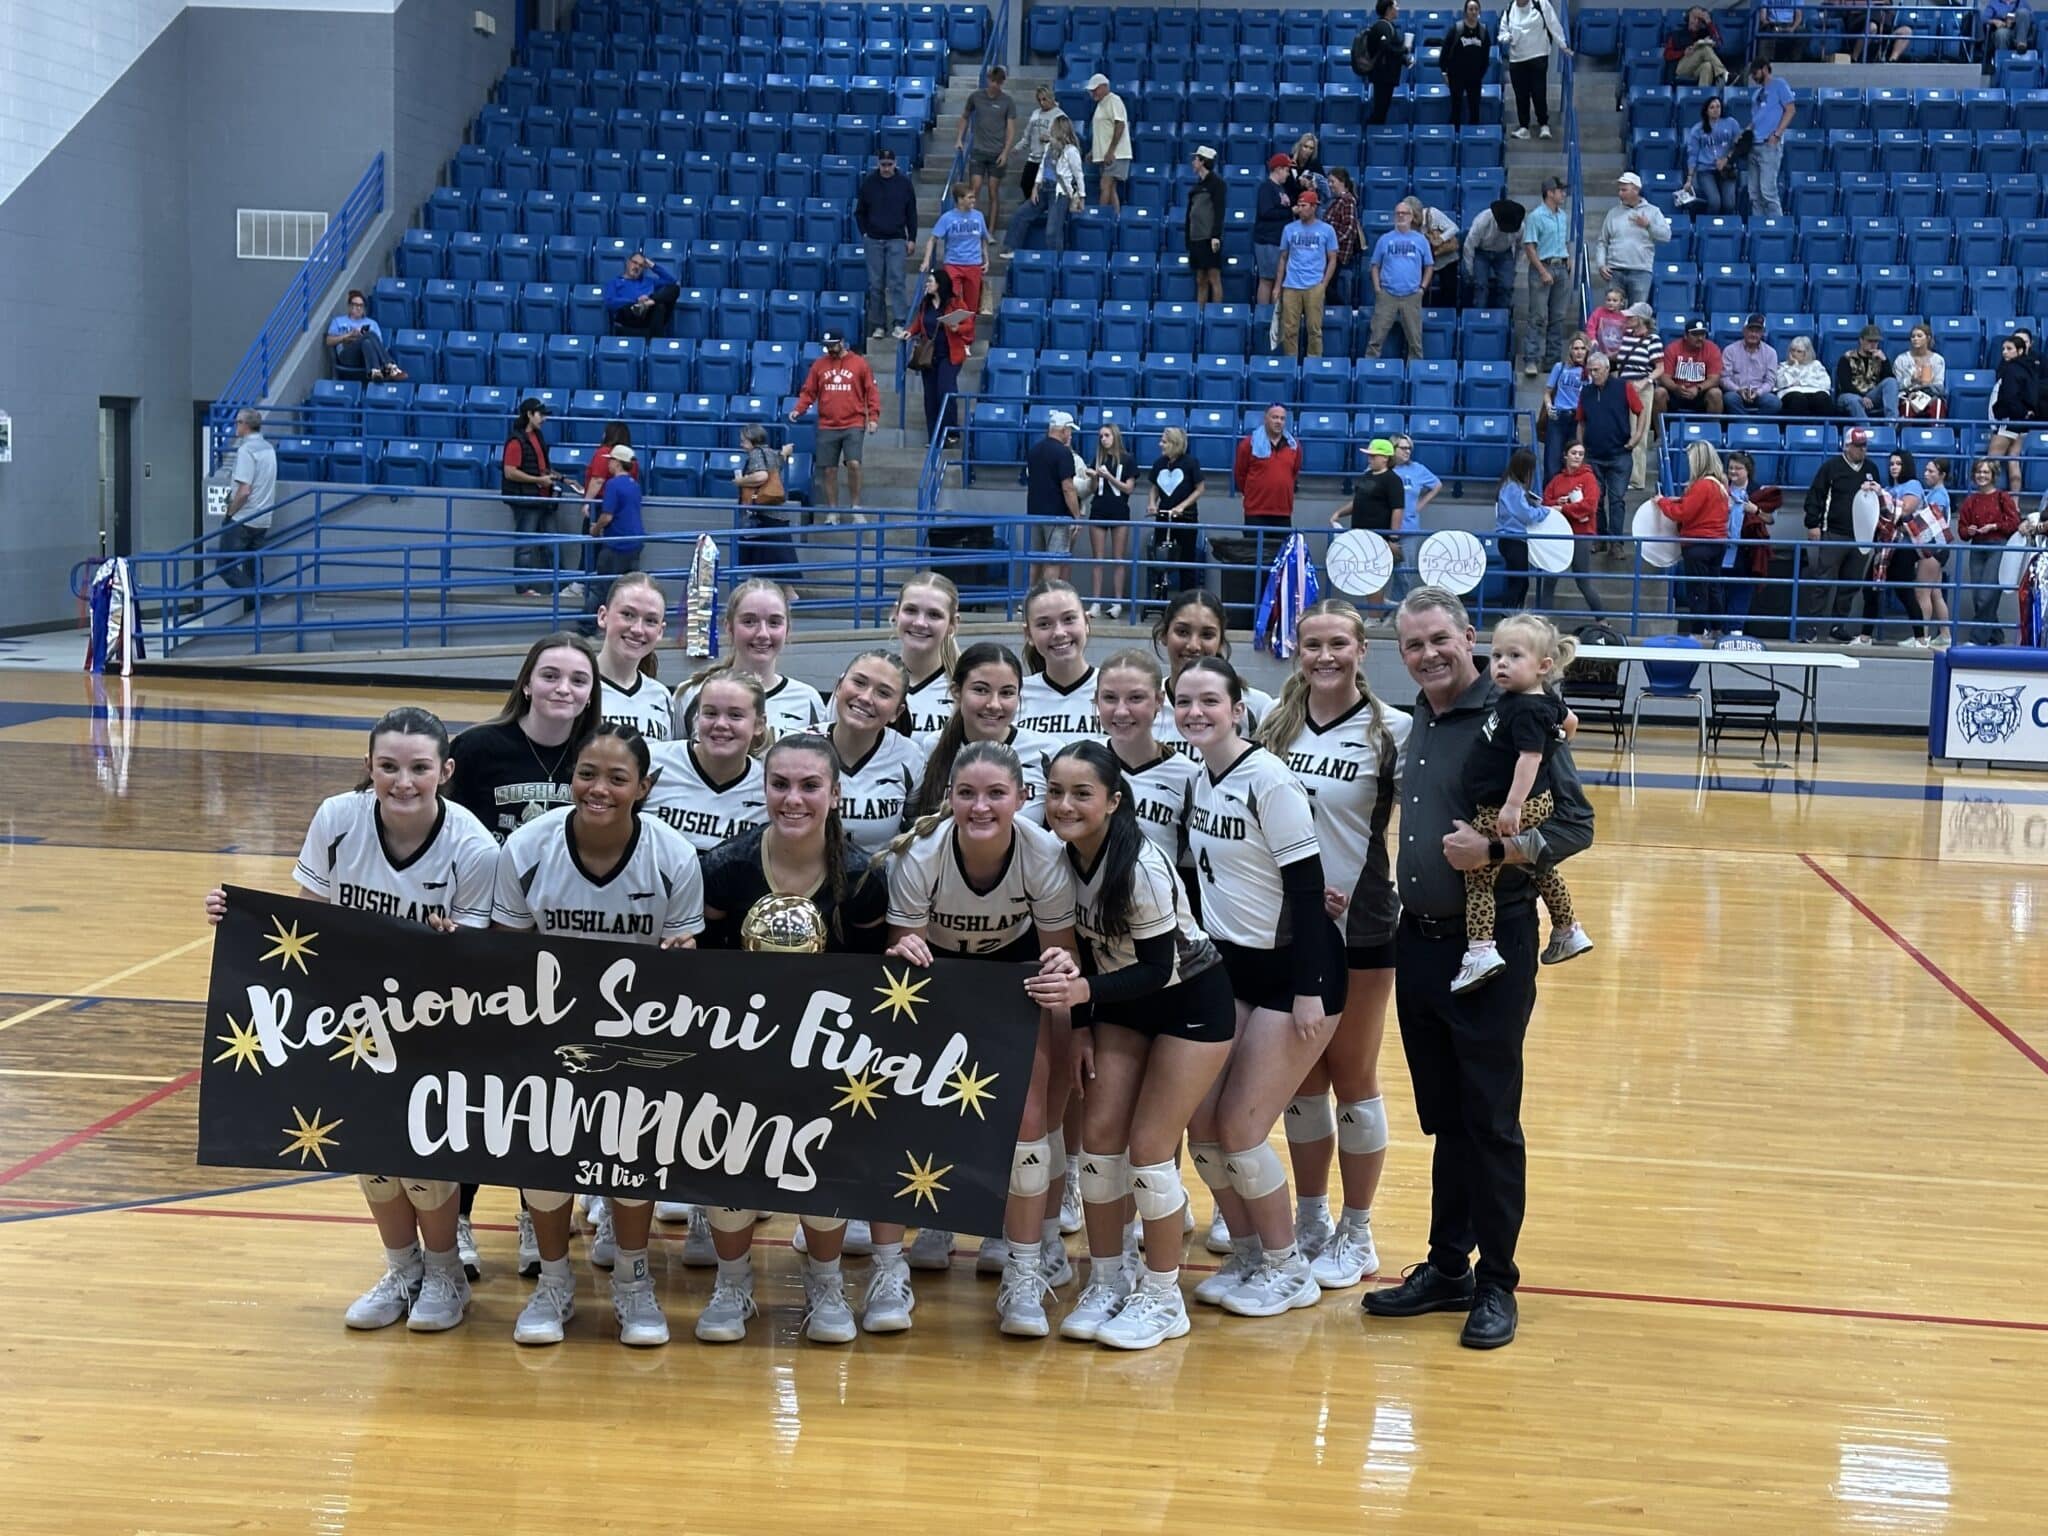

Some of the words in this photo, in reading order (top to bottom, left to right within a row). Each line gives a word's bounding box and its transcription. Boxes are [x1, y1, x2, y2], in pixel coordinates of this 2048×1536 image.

[494, 782, 576, 805] BUSHLA
[1199, 847, 1215, 884] 4
[544, 908, 654, 936] BUSHLAND
[246, 950, 577, 1073] Regional
[594, 957, 780, 1051] Semi
[790, 990, 968, 1107] Final
[407, 1070, 834, 1192] CHAMPIONS
[574, 1160, 604, 1186] 3A
[611, 1163, 648, 1188] Div
[653, 1166, 668, 1191] 1
